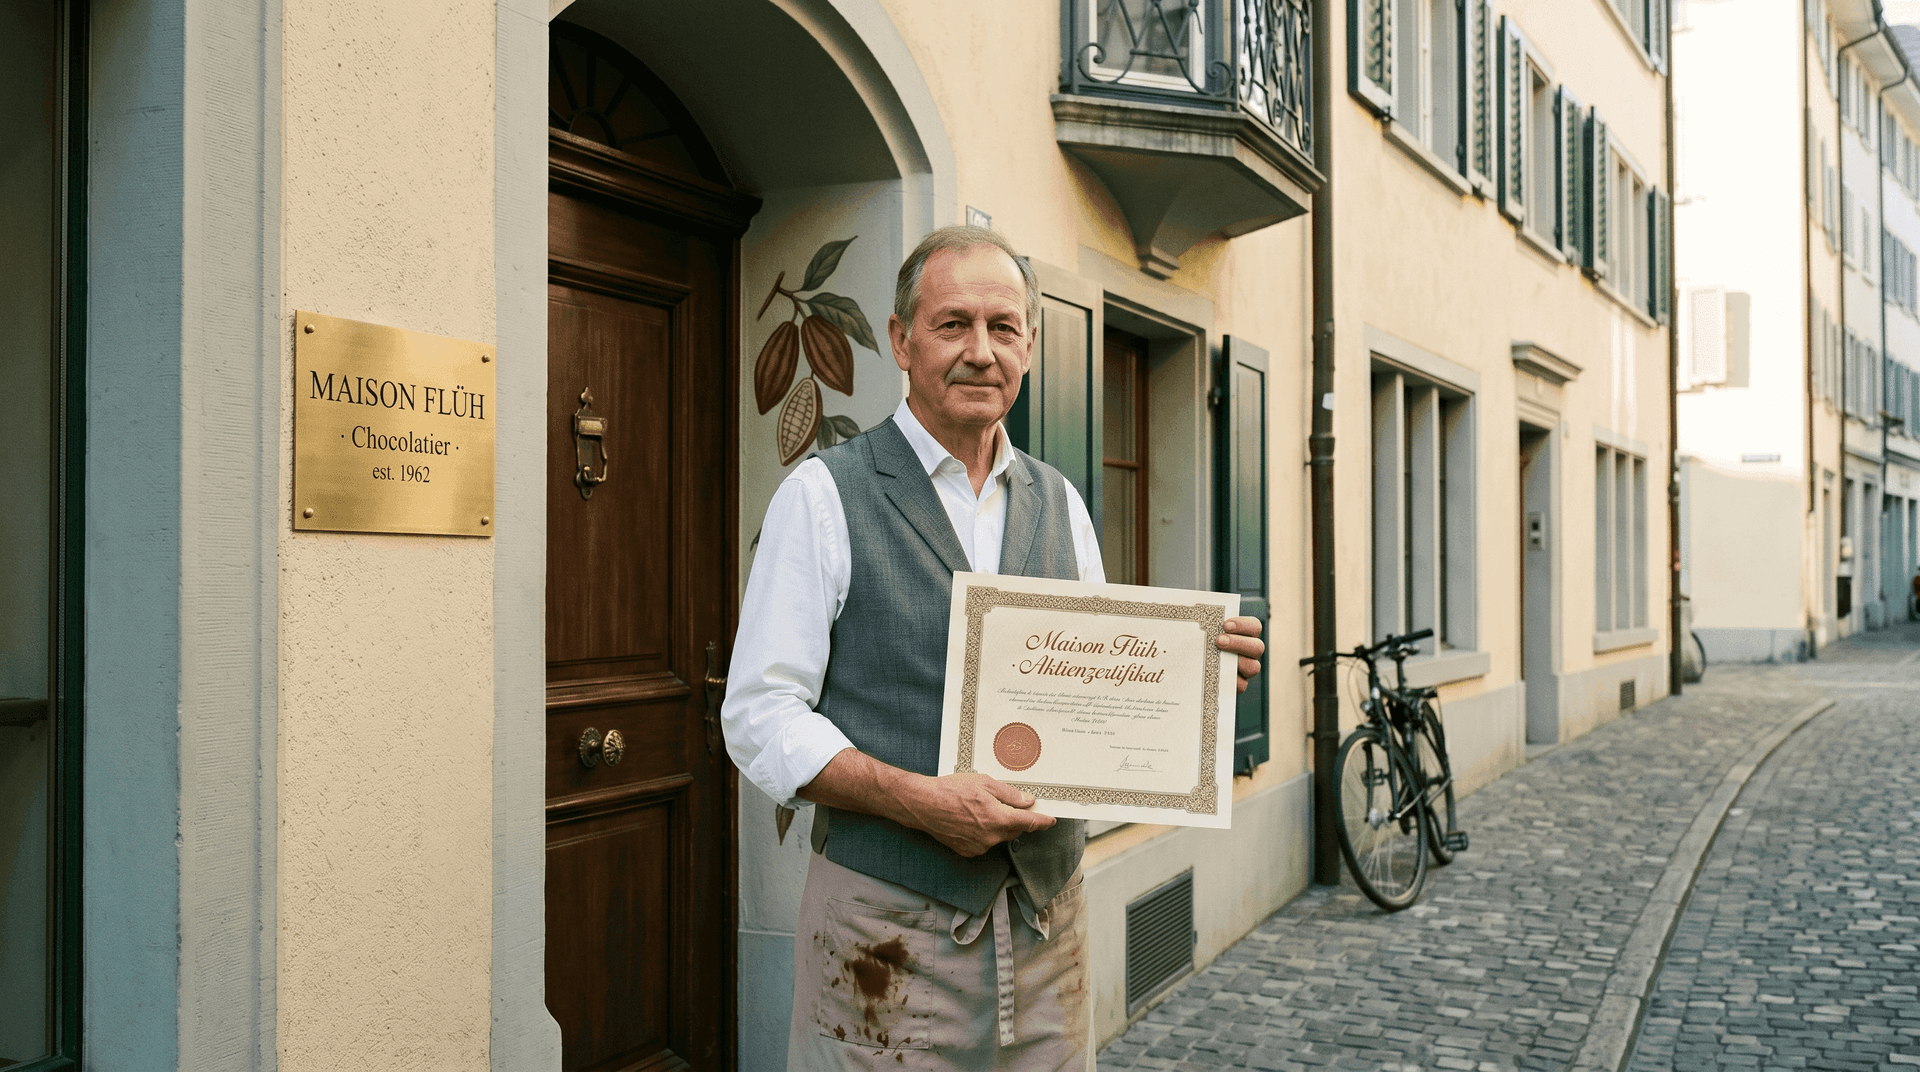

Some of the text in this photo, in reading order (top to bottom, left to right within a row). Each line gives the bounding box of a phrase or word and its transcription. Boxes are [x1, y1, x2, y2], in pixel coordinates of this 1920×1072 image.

[310, 370, 485, 420] MAISON FLÜH
[351, 425, 451, 456] Chocolatier
[372, 464, 430, 483] est. 1962
[1025, 630, 1160, 658] Maison Flüh
[1019, 654, 1165, 687] Aktienzertifikat
